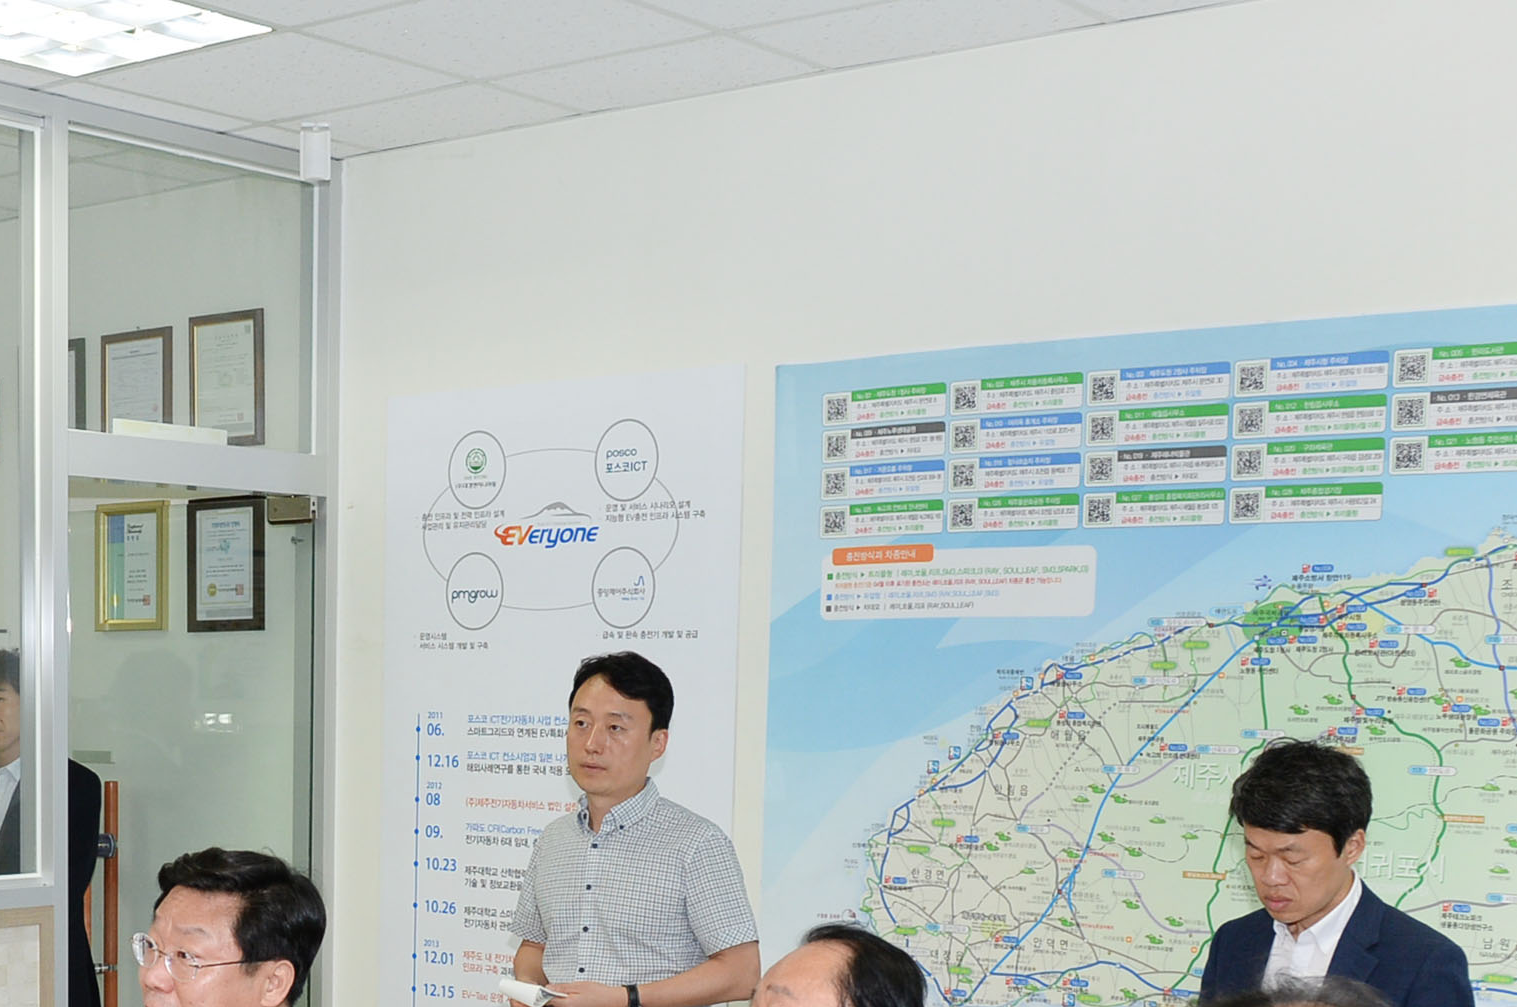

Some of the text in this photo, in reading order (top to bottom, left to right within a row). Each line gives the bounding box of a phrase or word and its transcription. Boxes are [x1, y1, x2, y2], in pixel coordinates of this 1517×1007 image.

[606, 448, 637, 460] posco
[605, 460, 648, 473] 포스코ICT
[494, 524, 599, 548] EVeryone
[451, 589, 498, 604] pmgrow
[427, 711, 443, 719] 2011
[467, 715, 488, 724] 포스코
[426, 723, 445, 736] 06.
[467, 727, 515, 737] 스마트그리드와
[517, 728, 538, 738] 연계된
[427, 754, 459, 768] 12.16
[466, 751, 488, 760] 포스코
[516, 764, 530, 775] 통한
[532, 765, 547, 776] 국내
[549, 766, 563, 776] 적용
[426, 782, 443, 790] 2012
[426, 793, 441, 806] 08
[425, 825, 443, 838] 09.
[465, 835, 499, 846] 전기자동차
[425, 857, 457, 872] 10.23
[464, 866, 498, 877] 제주대학교
[464, 878, 478, 888] 기술
[480, 879, 487, 889] 및
[425, 900, 457, 915] 10.26
[463, 906, 498, 917] 제주대학교
[463, 918, 498, 930] 전기자동차
[424, 939, 440, 948] 2013
[424, 950, 455, 965] 12.01
[423, 983, 455, 999] 12.15
